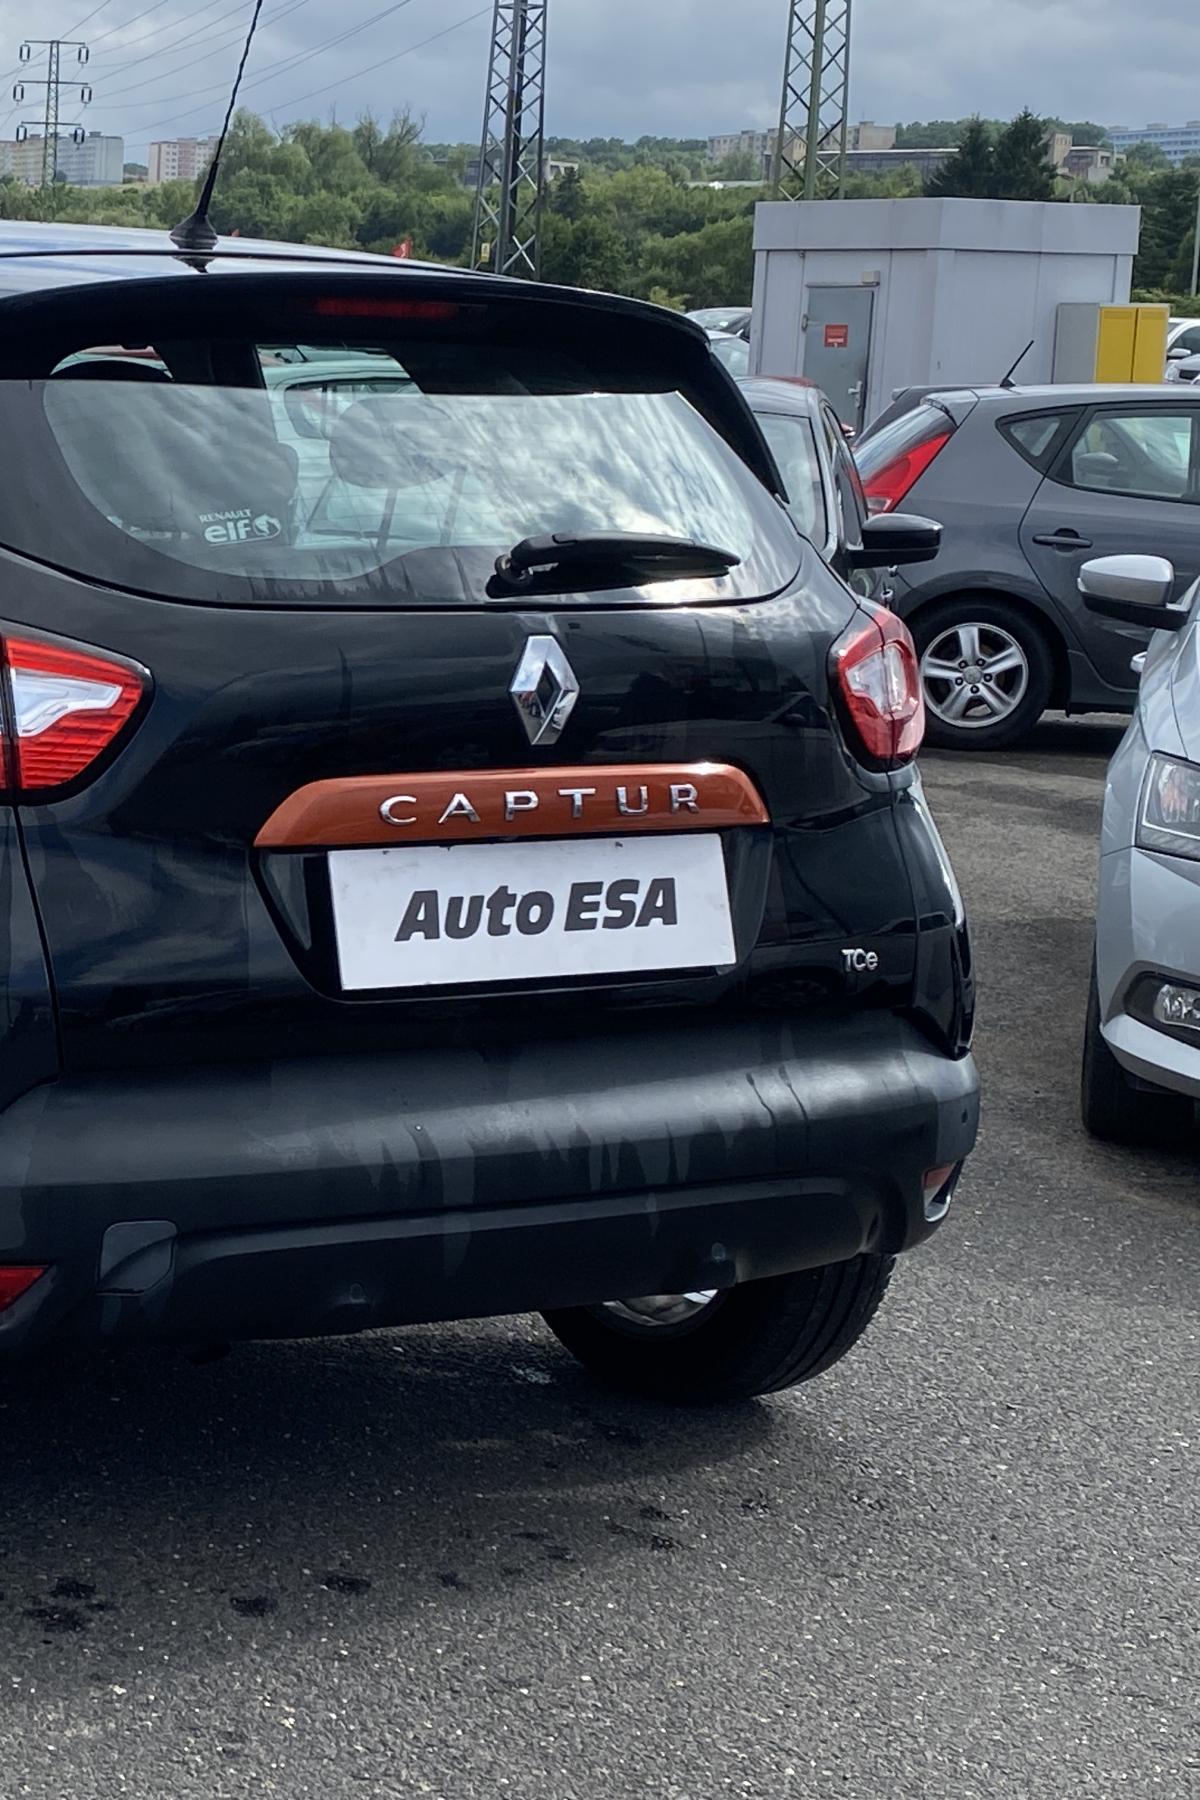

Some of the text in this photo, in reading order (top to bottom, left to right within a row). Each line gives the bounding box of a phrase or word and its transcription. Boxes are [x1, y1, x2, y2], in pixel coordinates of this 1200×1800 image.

[200, 508, 252, 524] RENAULT
[204, 519, 252, 543] elf
[379, 783, 701, 826] CAPTUR
[394, 877, 679, 942] Auto ESA
[841, 948, 879, 971] TCe
